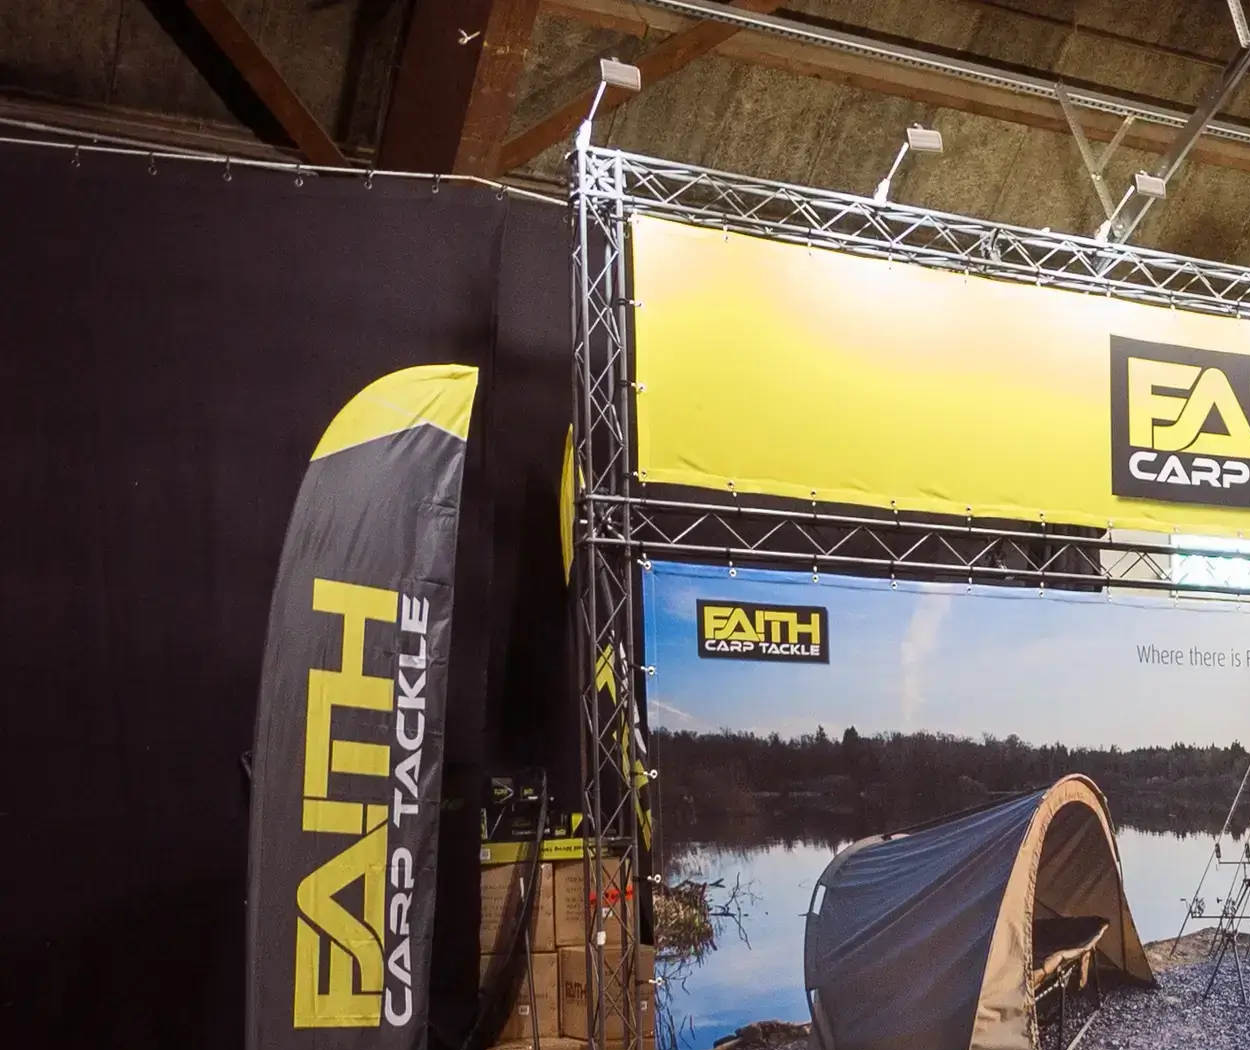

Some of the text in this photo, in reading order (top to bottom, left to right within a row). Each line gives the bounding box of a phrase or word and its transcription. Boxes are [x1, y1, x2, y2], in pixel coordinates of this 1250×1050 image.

[1129, 451, 1250, 488] CARP
[703, 605, 821, 645] FAITH
[704, 639, 821, 656] CARP TACKLE
[1136, 643, 1184, 666] Where
[1189, 646, 1226, 668] there
[1231, 648, 1242, 668] is
[294, 578, 399, 1028] FAITH
[384, 594, 430, 1027] CARP TACKLE
